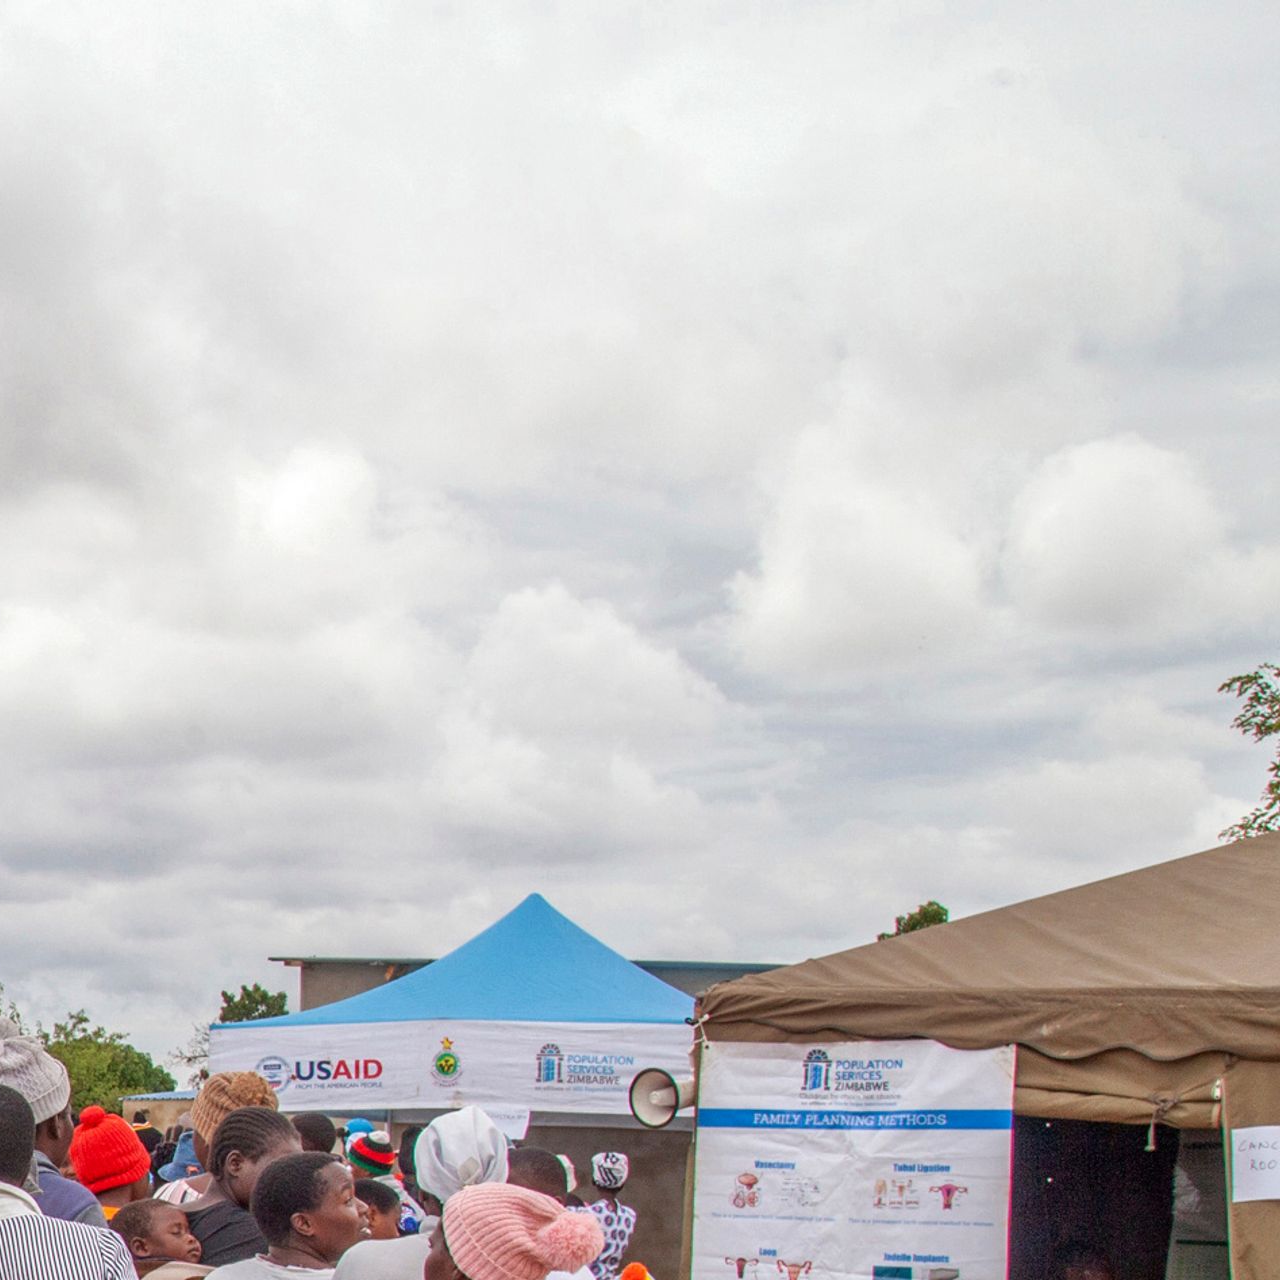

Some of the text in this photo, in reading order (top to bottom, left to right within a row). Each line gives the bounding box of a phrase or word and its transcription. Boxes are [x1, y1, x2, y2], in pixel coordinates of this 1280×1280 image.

[567, 1054, 635, 1065] POPULATION
[295, 1059, 383, 1081] USAID
[566, 1064, 615, 1075] SERVICES
[566, 1075, 620, 1085] ZIMBABWE
[834, 1081, 889, 1092] ZIMBABWE
[753, 1113, 947, 1126] FAMILY PLANNING METHODS
[917, 1163, 951, 1173] Ligation
